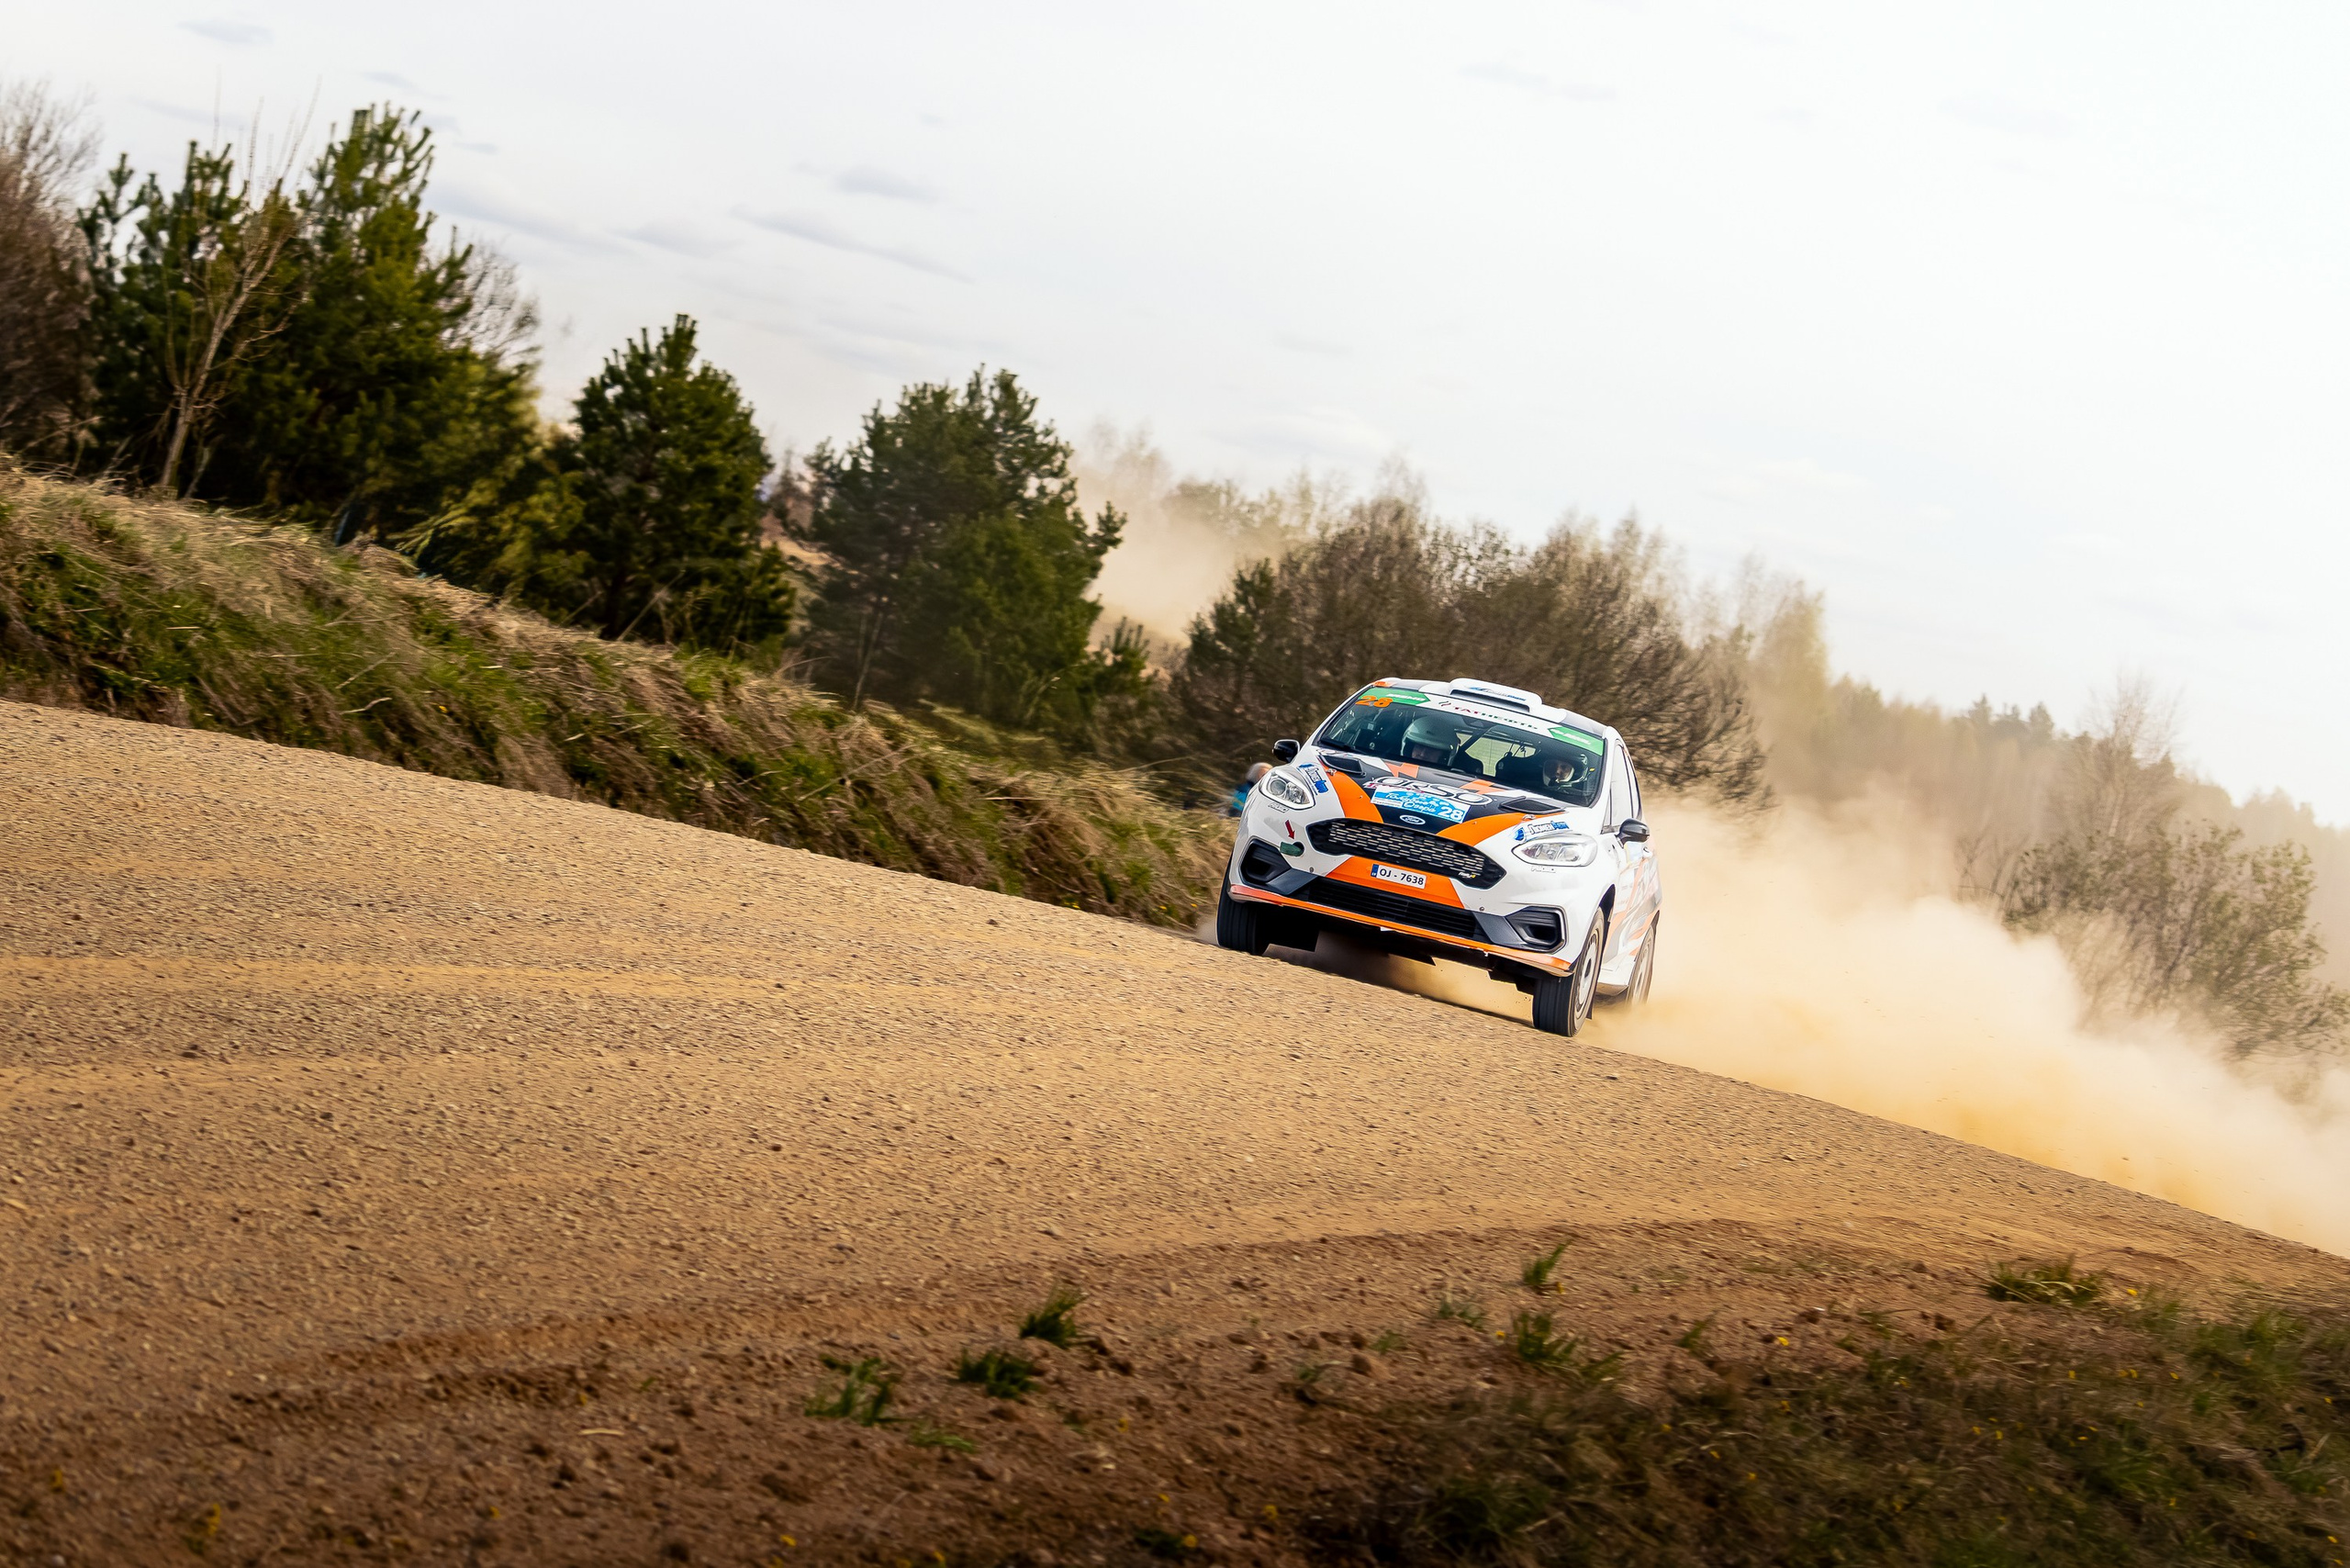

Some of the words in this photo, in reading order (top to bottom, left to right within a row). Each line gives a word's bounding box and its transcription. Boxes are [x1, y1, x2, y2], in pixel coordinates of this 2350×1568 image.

[1355, 695, 1393, 708] 28
[1438, 807, 1464, 821] 28
[1401, 873, 1424, 885] 7638
